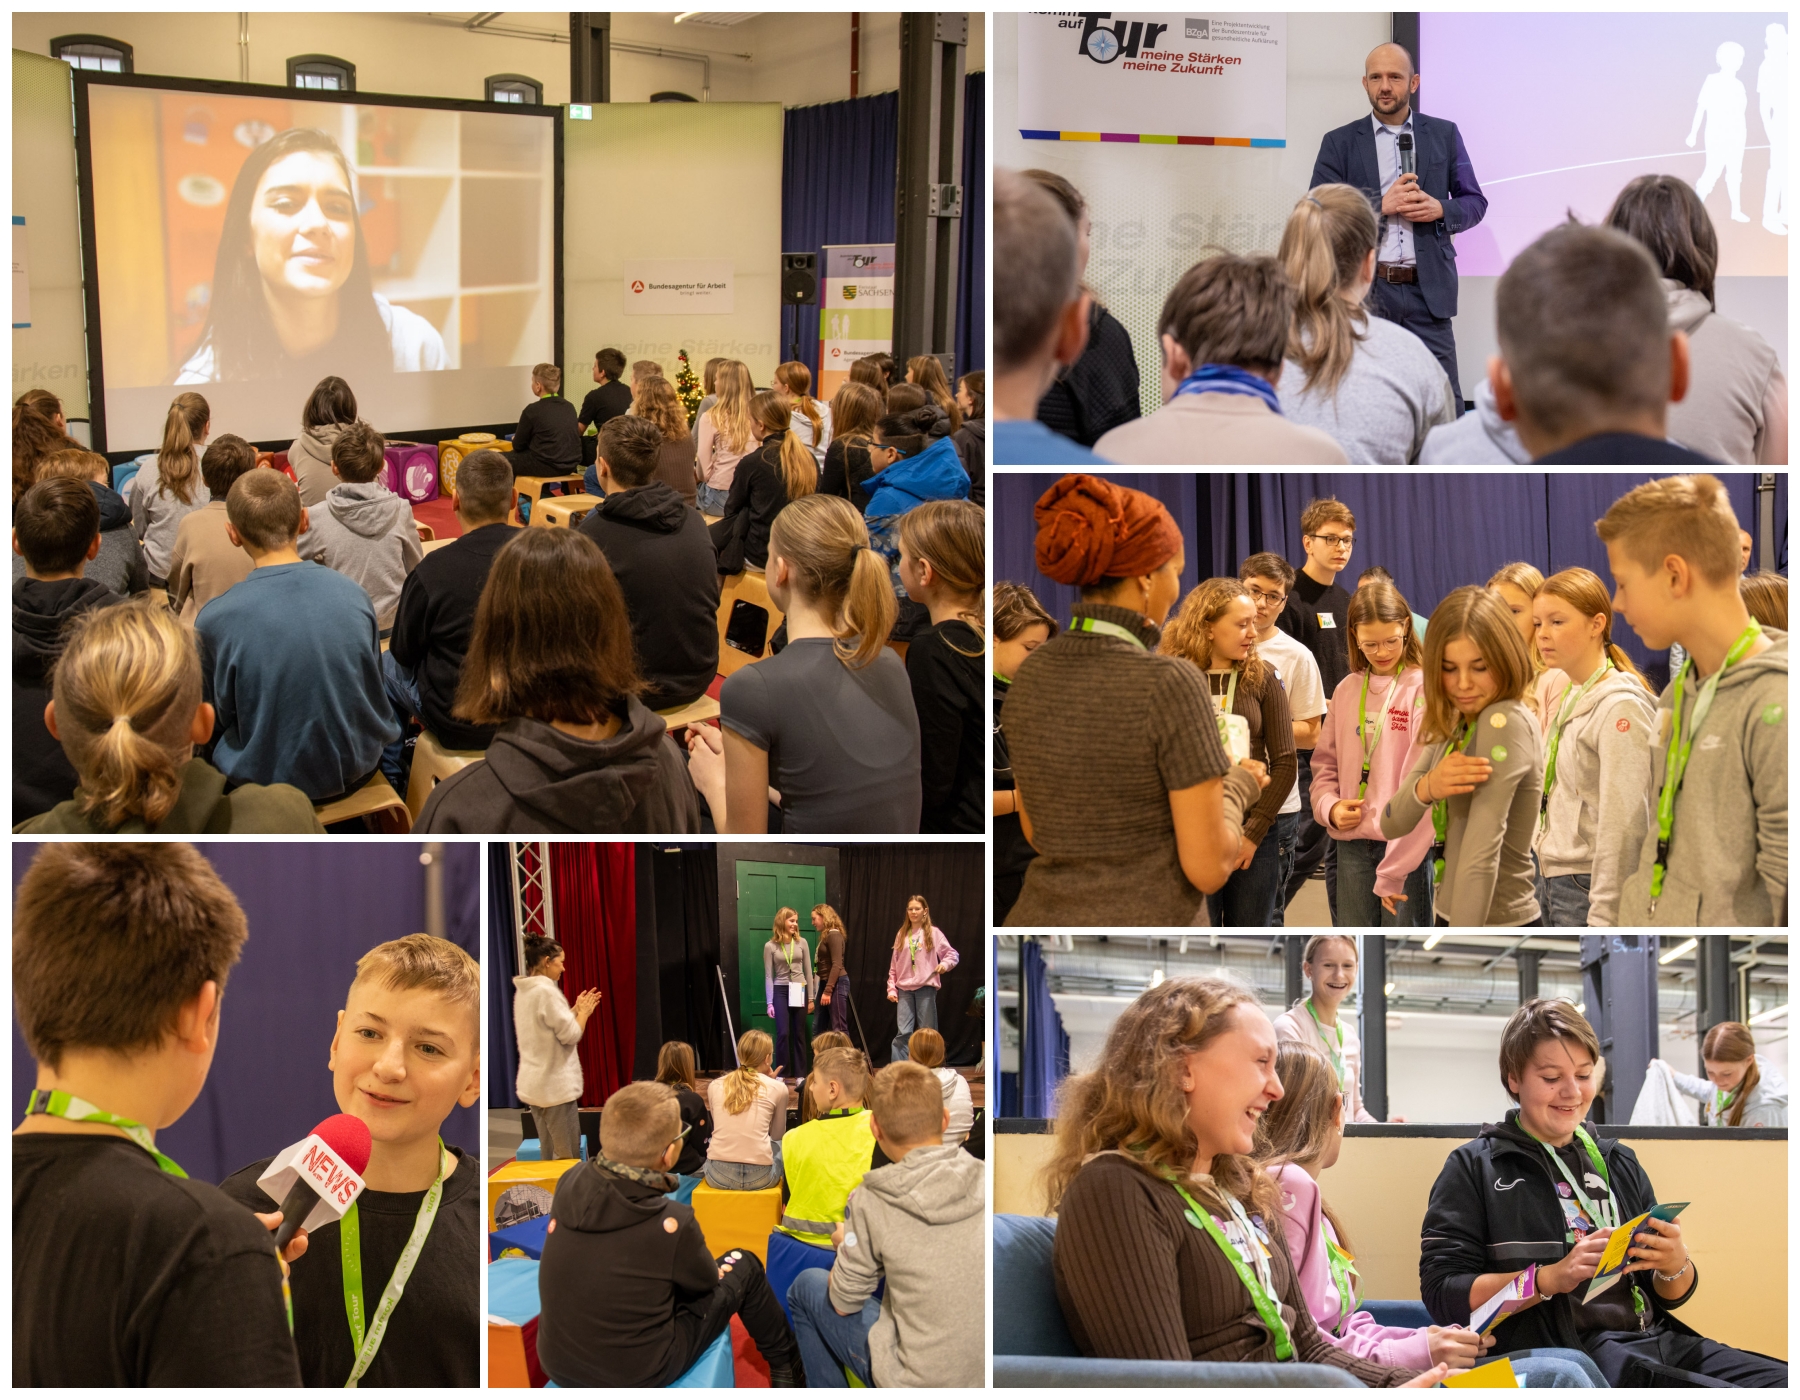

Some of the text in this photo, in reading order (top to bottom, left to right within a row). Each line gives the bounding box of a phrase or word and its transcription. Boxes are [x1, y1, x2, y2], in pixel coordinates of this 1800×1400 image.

[1058, 19, 1083, 29] auf
[1223, 21, 1270, 30] Projektentwicklung
[1186, 28, 1208, 38] BZgA
[1221, 28, 1259, 36] Bundeszentrale
[1251, 37, 1278, 45] Aufklärung
[1140, 50, 1242, 65] meine Stärken
[1122, 61, 1224, 75] meine Zukunft
[681, 339, 772, 356] Stärken
[301, 1144, 358, 1205] NEWS
[351, 1294, 360, 1322] Tour
